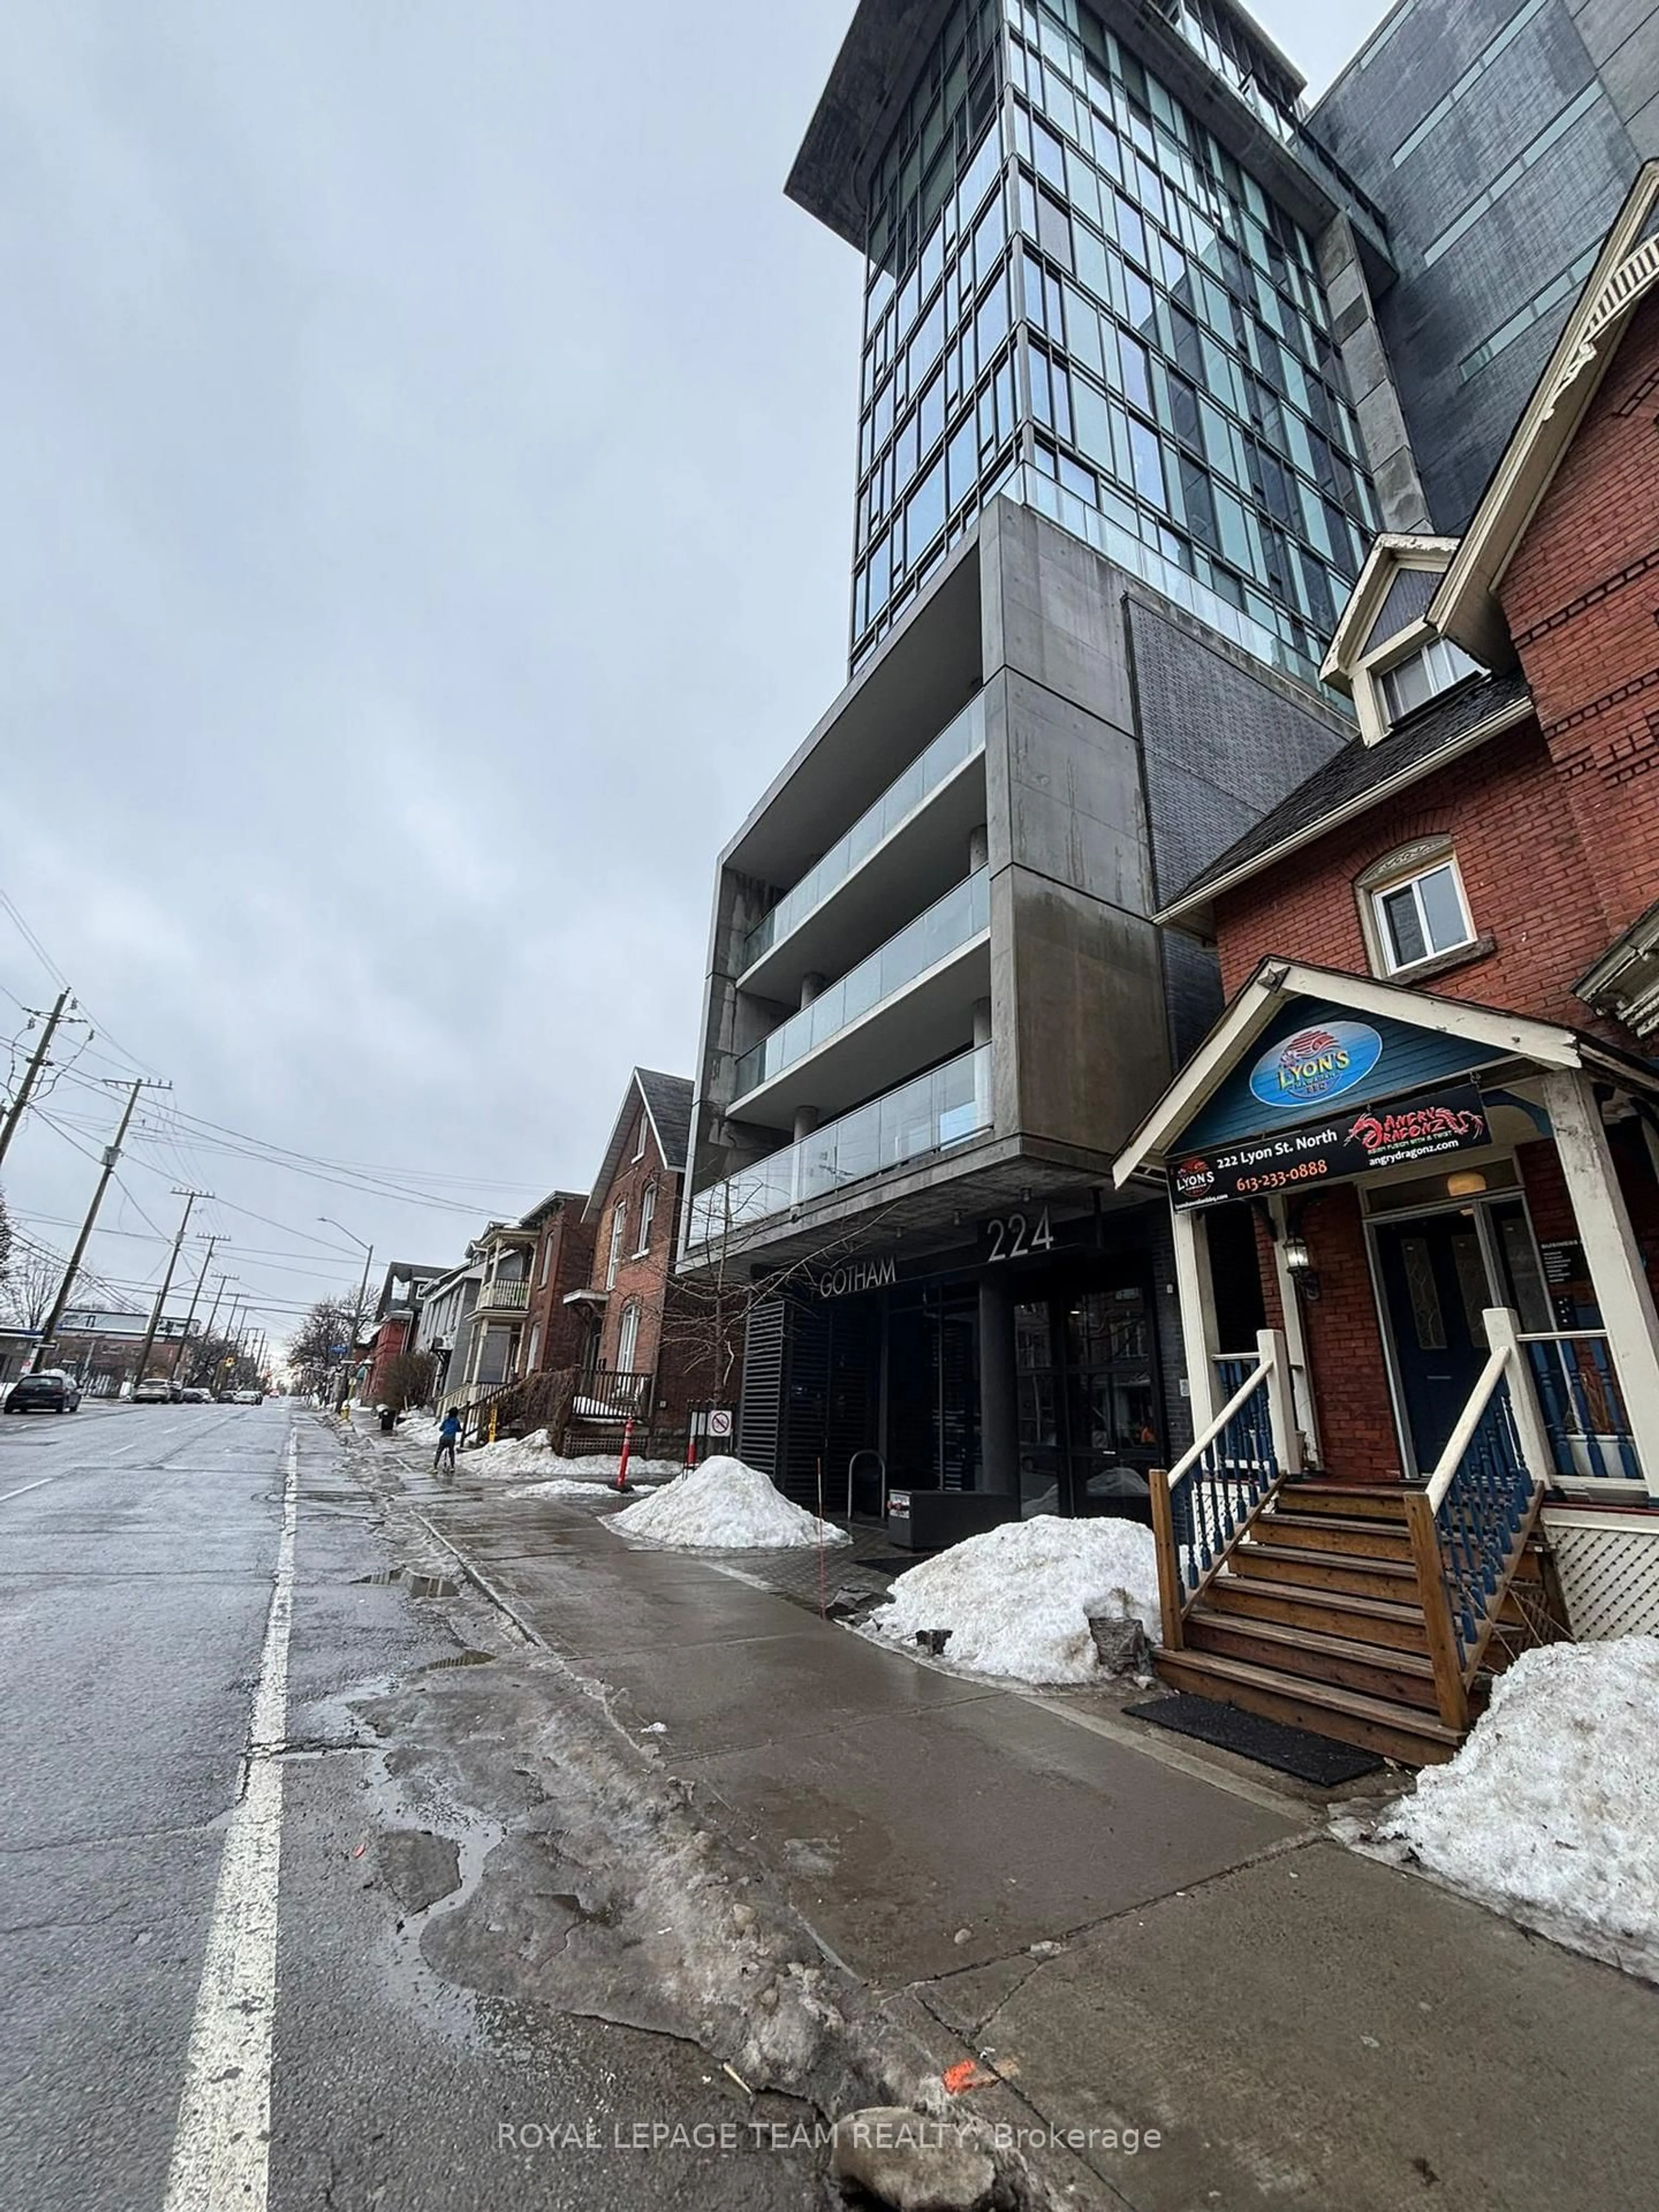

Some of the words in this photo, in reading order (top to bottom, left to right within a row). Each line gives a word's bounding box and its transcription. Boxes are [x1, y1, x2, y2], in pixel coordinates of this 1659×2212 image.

[1384, 1106, 1436, 1131] ANGRY
[1217, 1156, 1239, 1169] 222
[1240, 1147, 1272, 1165] Lyon
[1274, 1141, 1294, 1156] St.
[1296, 1129, 1337, 1150] North
[1369, 1140, 1459, 1166] angrydragonz.com
[1236, 1160, 1328, 1191] 613-233-0888
[987, 1205, 1054, 1262] 224
[820, 1256, 896, 1297] GOTHAM
